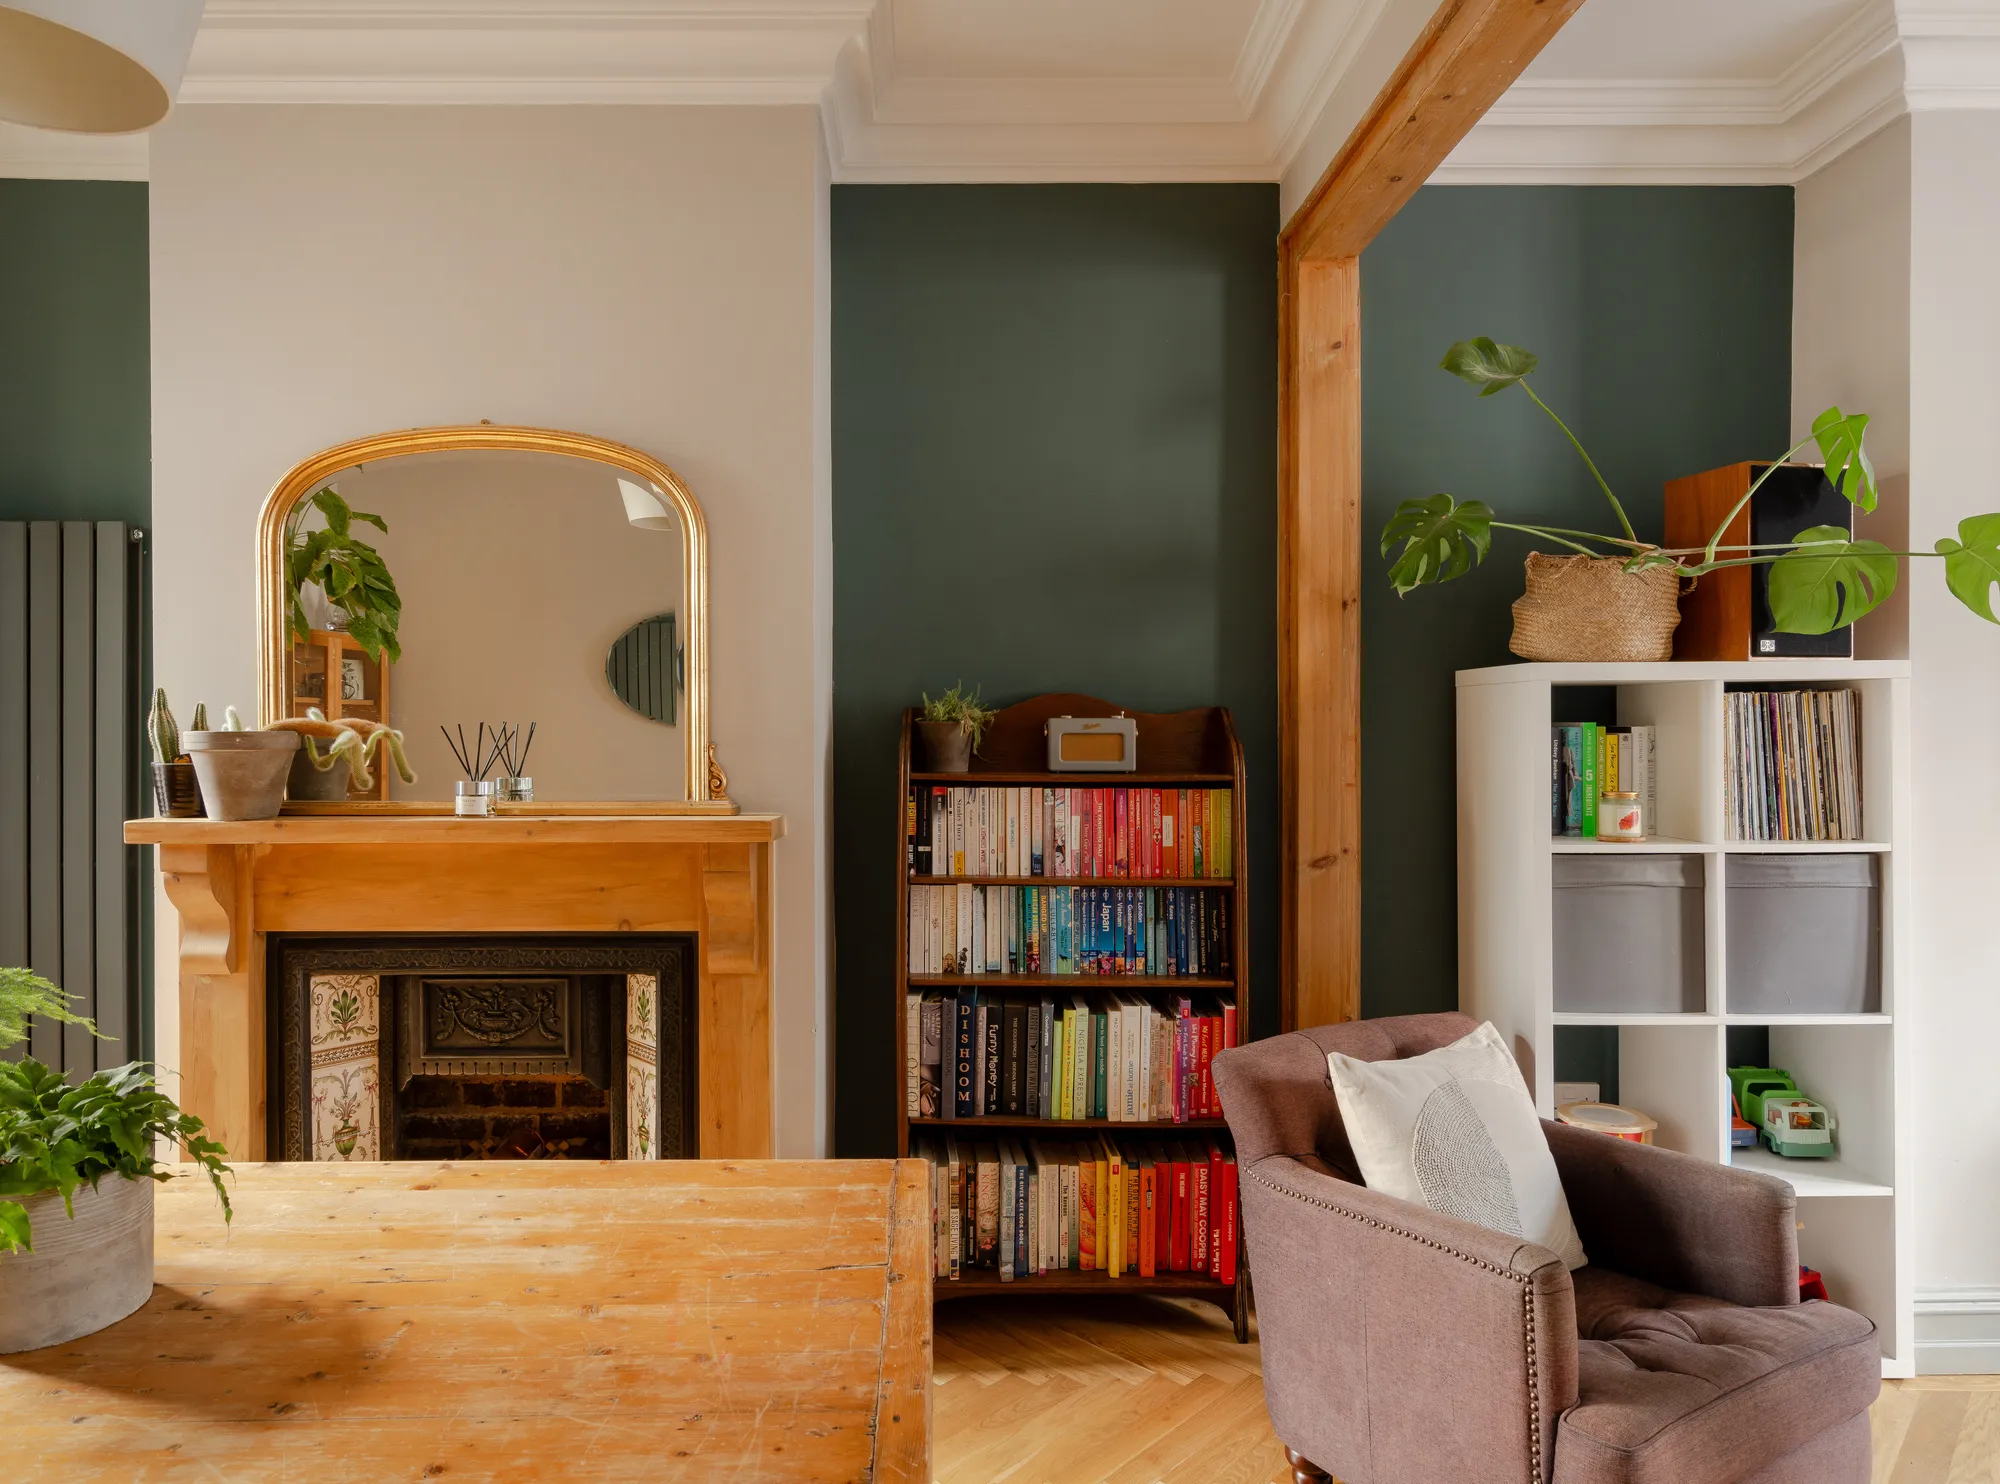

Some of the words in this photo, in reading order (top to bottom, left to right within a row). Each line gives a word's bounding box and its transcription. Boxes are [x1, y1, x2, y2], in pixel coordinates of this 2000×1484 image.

[1608, 742, 1616, 754] Sara
[1586, 769, 1593, 781] 5
[1608, 773, 1616, 783] Sex
[1083, 838, 1091, 850] Cups
[1041, 923, 1047, 933] UP
[1100, 903, 1112, 932] Japan
[1029, 1010, 1039, 1031] HARPER
[988, 1024, 999, 1054] Funny
[1190, 1035, 1199, 1058] Mummy
[958, 1005, 971, 1101] DISHOOM
[1029, 1060, 1039, 1068] SET
[988, 1056, 999, 1086] Money
[908, 1058, 919, 1113] POLPO
[1028, 1077, 1038, 1107] WATCHMAN
[1125, 1089, 1135, 1116] jamie
[981, 1173, 989, 1200] KING
[1199, 1168, 1207, 1195] DAISY
[1199, 1197, 1207, 1217] MAY
[1198, 1220, 1207, 1259] COOPER
